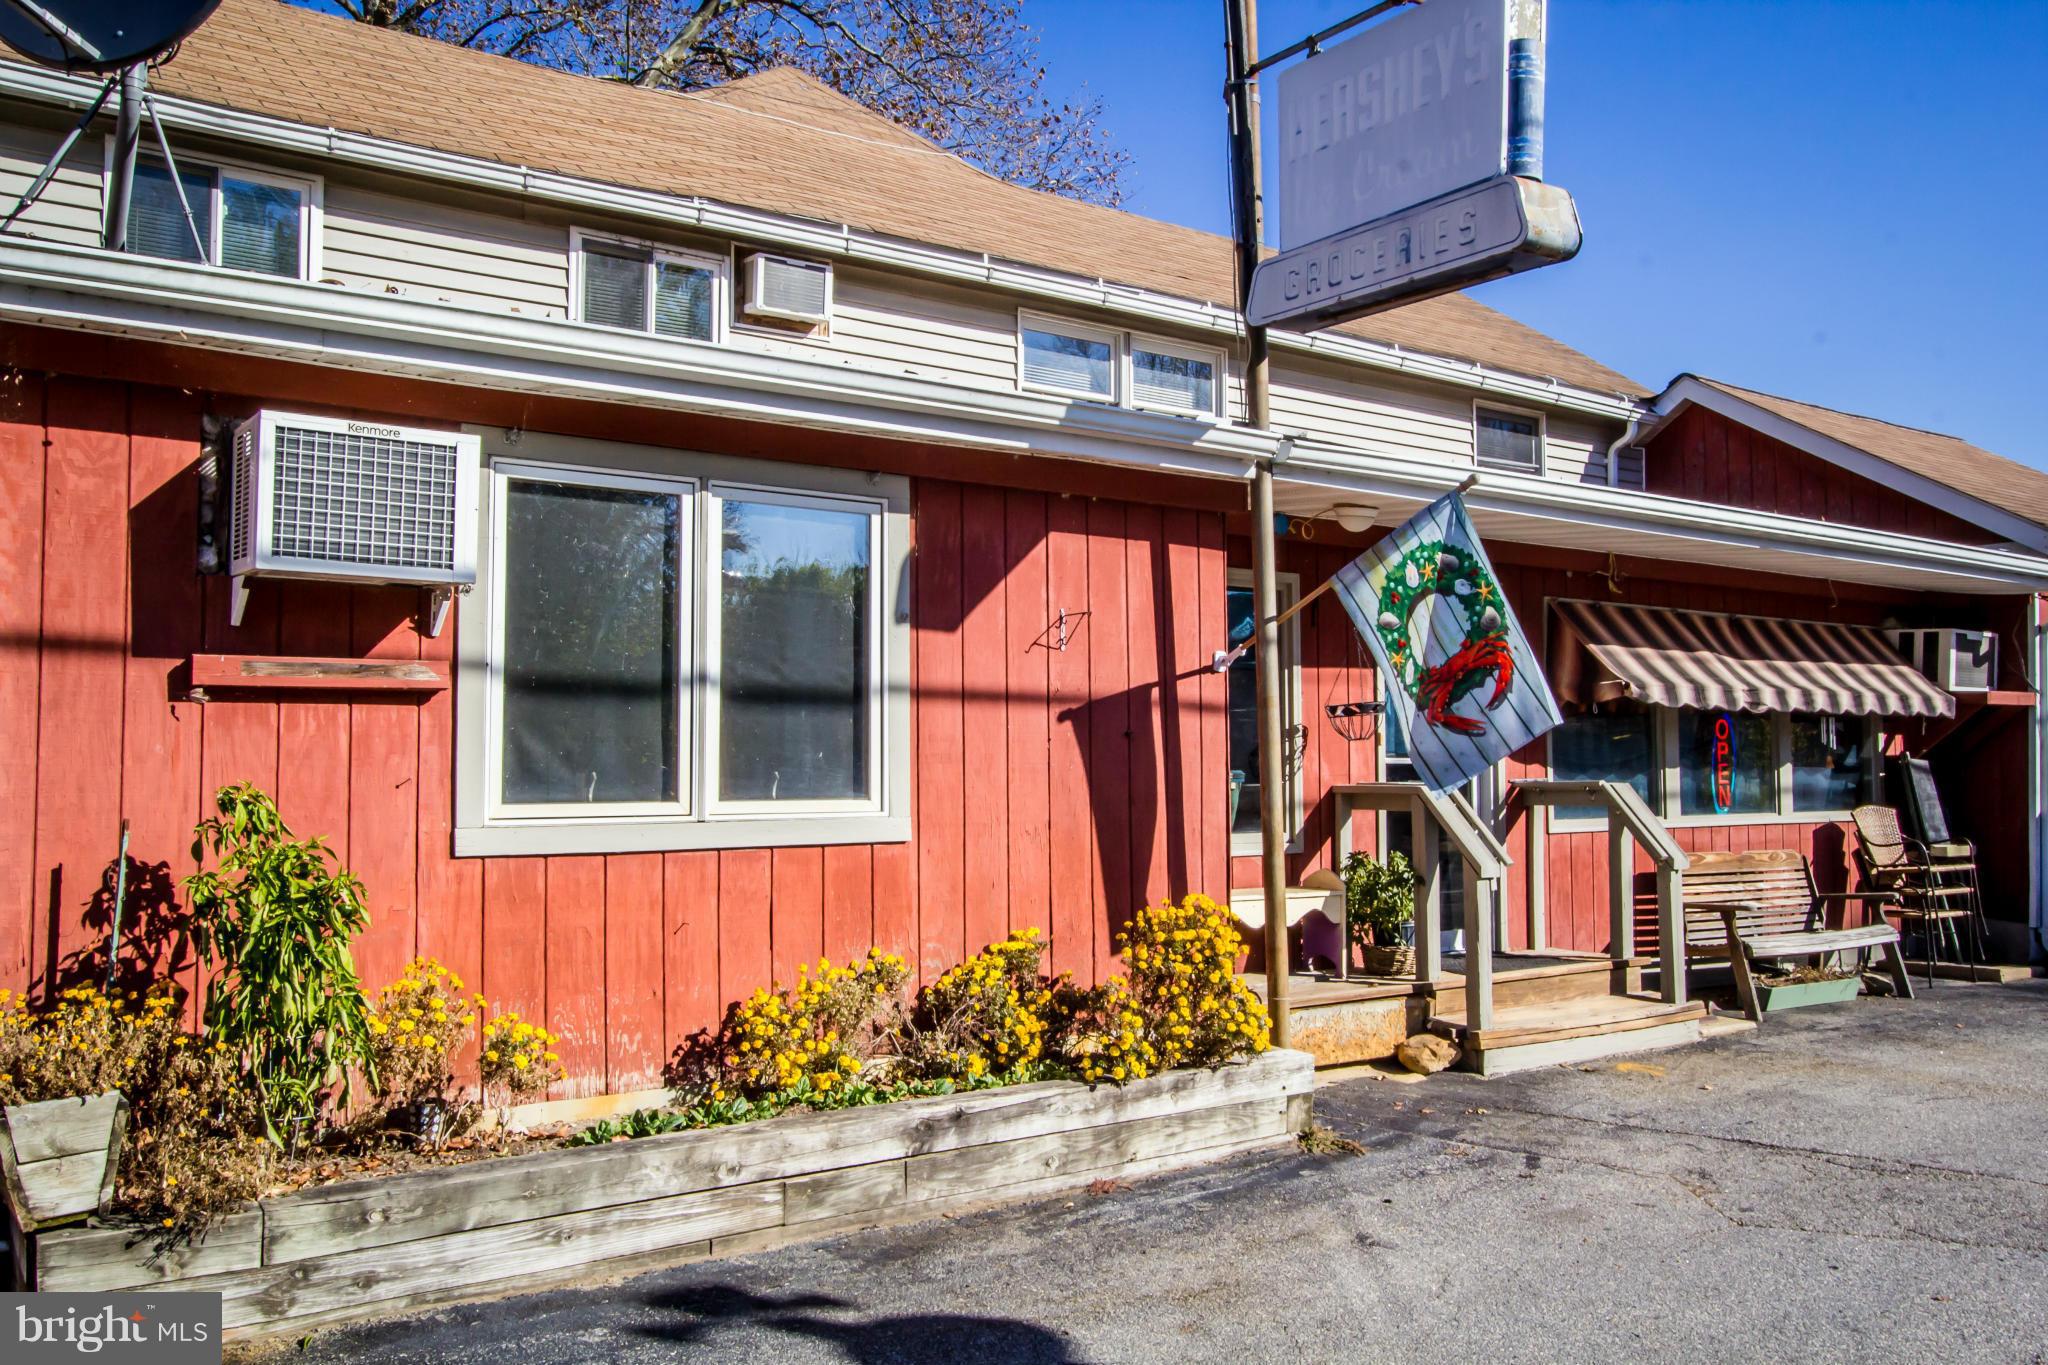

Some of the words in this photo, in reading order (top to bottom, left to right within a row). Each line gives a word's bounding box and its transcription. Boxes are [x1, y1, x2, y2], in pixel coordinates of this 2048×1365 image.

[1284, 204, 1478, 301] GROCERIES
[347, 423, 401, 438] Kenmore
[1715, 718, 1731, 808] OPEN
